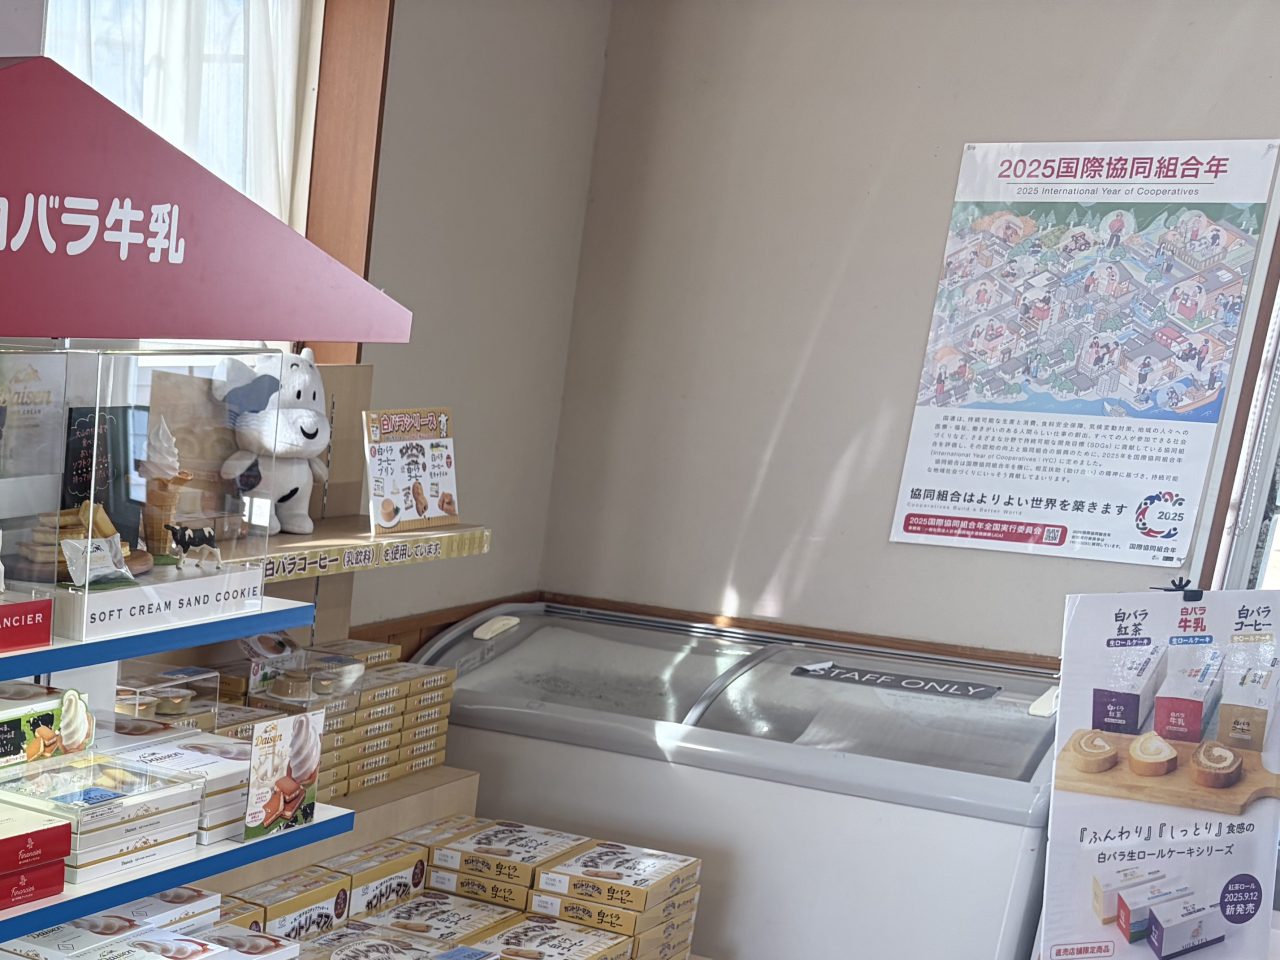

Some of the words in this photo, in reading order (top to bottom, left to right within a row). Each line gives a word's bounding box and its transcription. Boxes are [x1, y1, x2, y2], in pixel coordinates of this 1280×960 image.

[998, 156, 1229, 181] 2025国際協同組合年
[1017, 187, 1038, 196] 2025
[1041, 187, 1099, 196] International
[1101, 187, 1121, 197] Year
[1123, 187, 1135, 196] of
[1136, 187, 1200, 197] Cooperatives
[910, 487, 1128, 516] 協同組合はよりよい世界を築きます
[1157, 511, 1184, 521] 2025
[1129, 543, 1177, 553] 国際協同組合年
[89, 609, 122, 625] SOFT
[129, 601, 172, 619] CREAM
[177, 595, 210, 610] SAND
[215, 586, 259, 604] COOKIE
[1180, 606, 1207, 616] 白バラ
[1114, 608, 1149, 622] 白バラ
[1116, 622, 1143, 636] 紅茶
[1178, 617, 1207, 633] 牛乳
[1234, 620, 1272, 632] コーヒー
[1109, 638, 1150, 647] 生ロールケーキ
[1171, 636, 1212, 645] 生ロールケーキ
[809, 667, 894, 685] STAFF
[900, 678, 986, 696] ONLY
[1097, 843, 1235, 864] 白バラ生ロールケーキシリーズ
[495, 871, 520, 880] コーヒー
[1228, 883, 1256, 891] 紅茶ロール
[1224, 892, 1259, 902] 2025.9.12
[1225, 903, 1256, 916] 新発売
